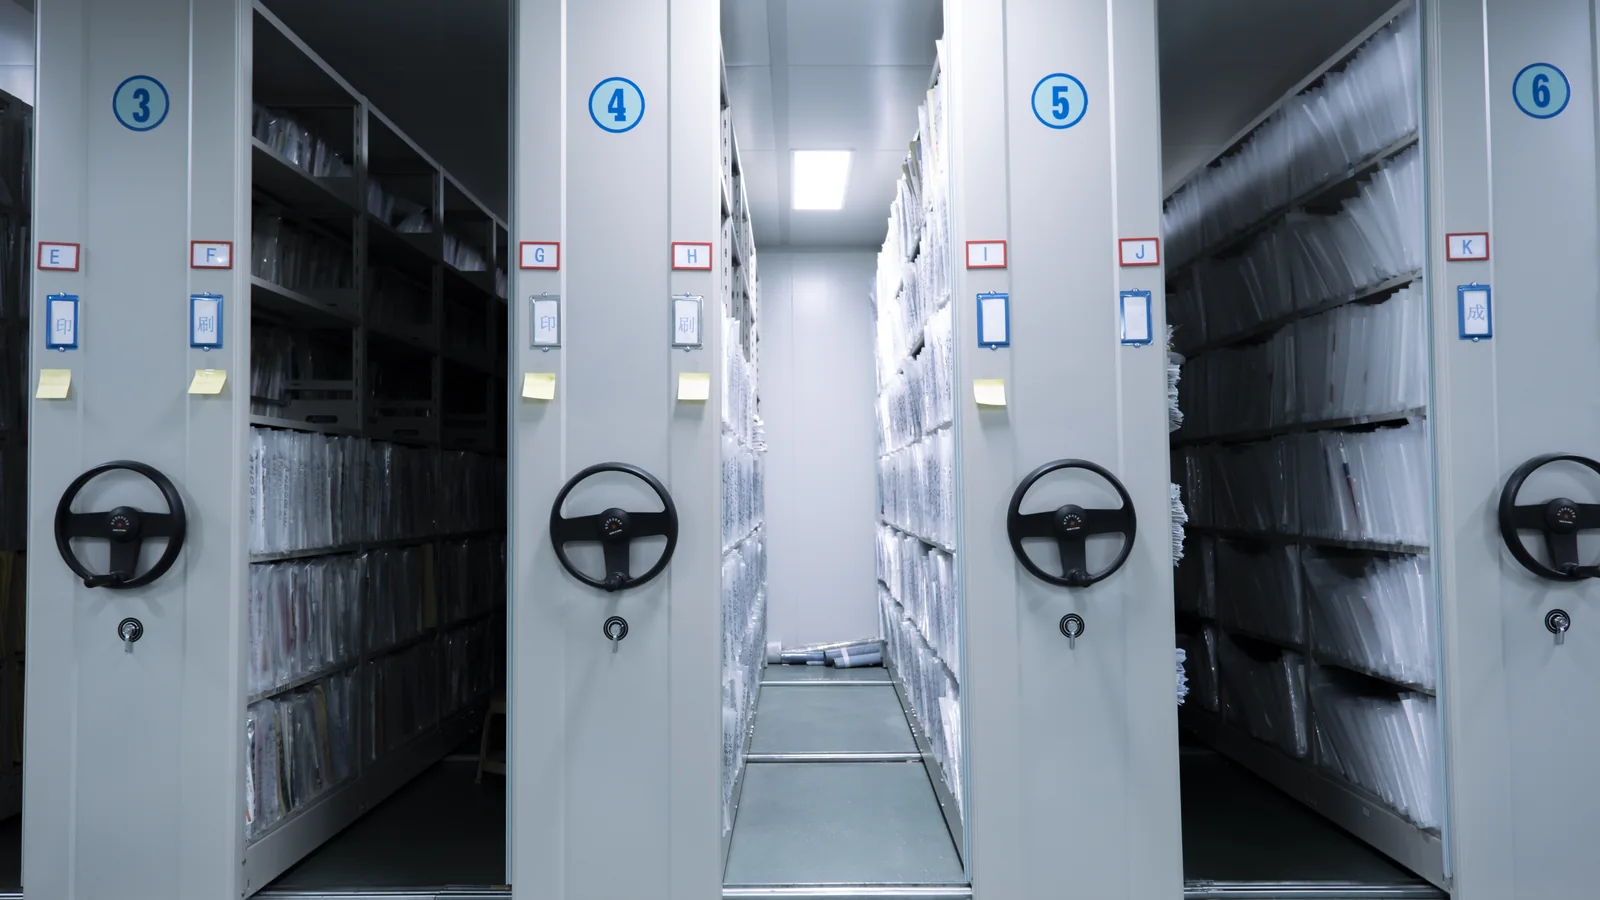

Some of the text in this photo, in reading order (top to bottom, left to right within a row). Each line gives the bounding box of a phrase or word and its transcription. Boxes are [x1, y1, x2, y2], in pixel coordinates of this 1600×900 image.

[1532, 73, 1550, 108] 6
[132, 88, 150, 122] 3
[608, 89, 627, 121] 4
[1052, 86, 1069, 119] 5
[206, 247, 217, 262] F
[534, 247, 545, 263] G
[687, 248, 698, 263] H
[983, 246, 988, 262] I
[1135, 244, 1145, 260] J
[1462, 239, 1473, 255] K
[50, 248, 60, 265] E
[1467, 304, 1485, 321] 成
[56, 317, 72, 335] 印
[197, 315, 214, 333] 刷
[540, 315, 556, 333] 印
[678, 316, 695, 334] 刷
